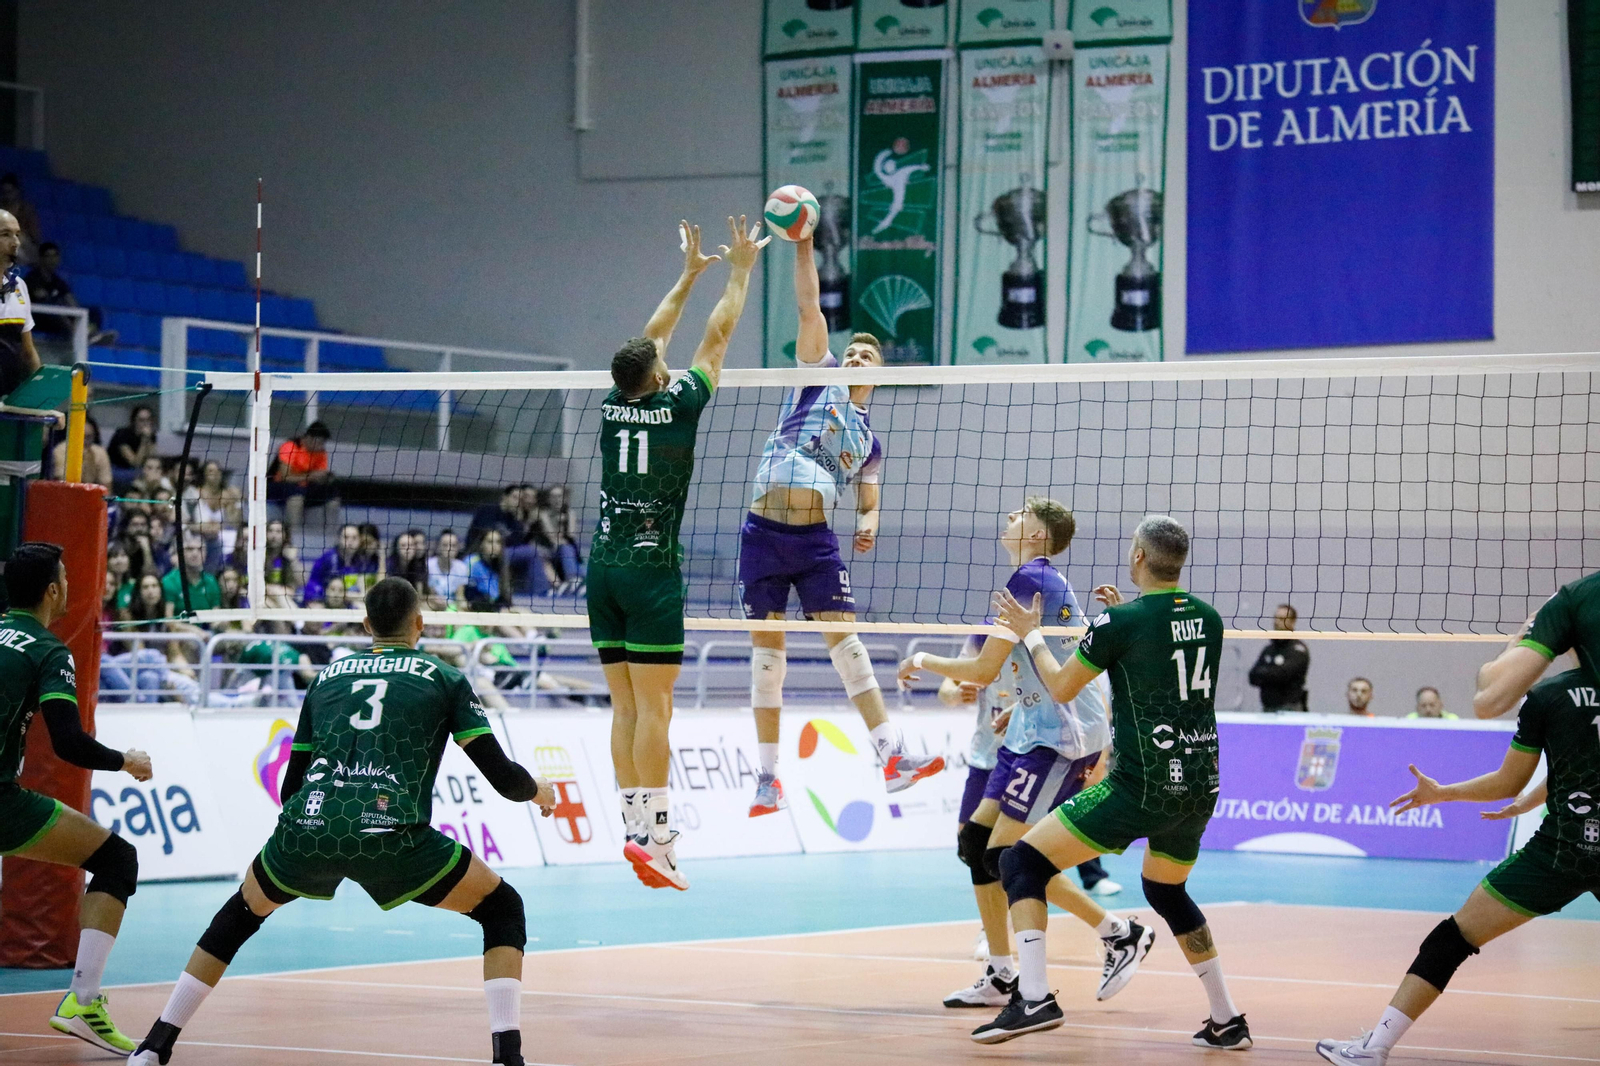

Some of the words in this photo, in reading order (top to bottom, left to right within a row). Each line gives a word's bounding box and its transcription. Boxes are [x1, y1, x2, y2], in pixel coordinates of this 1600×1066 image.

[1202, 38, 1479, 105] DIPUTACIÓN
[1206, 111, 1264, 151] DE
[1272, 87, 1473, 147] ALMERÍA
[614, 429, 649, 474] 11
[0, 629, 37, 653] DEZ
[1170, 618, 1206, 642] RUIZ
[316, 655, 438, 687] RODRÍGUEZ
[1170, 646, 1212, 701] 14
[350, 679, 389, 731] 3
[1567, 686, 1600, 708] VIZ
[331, 760, 400, 785] Andalucía
[1005, 767, 1038, 803] 21
[446, 775, 483, 804] DE
[1212, 796, 1307, 823] UTACIÓN
[1313, 802, 1342, 824] DE
[1346, 803, 1444, 829] ALMERÍA
